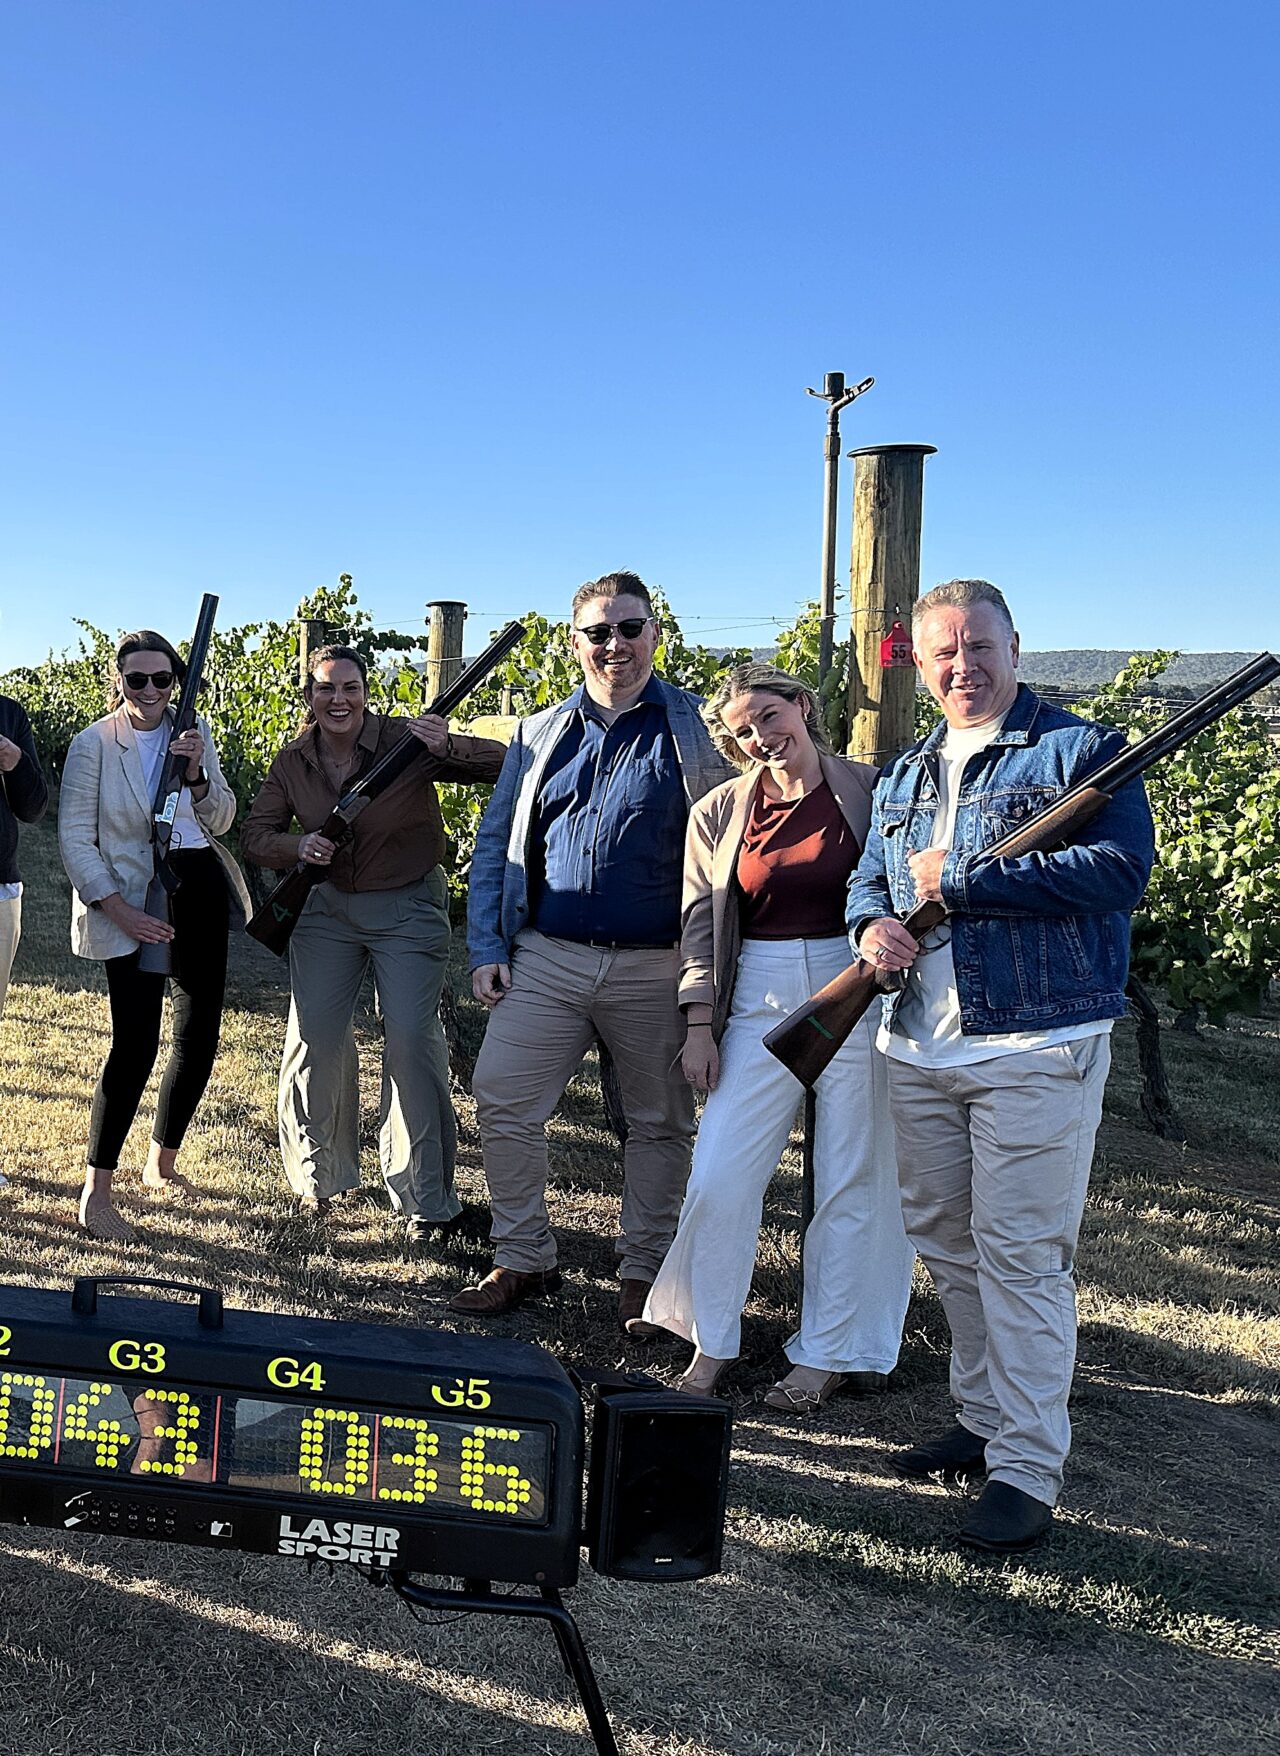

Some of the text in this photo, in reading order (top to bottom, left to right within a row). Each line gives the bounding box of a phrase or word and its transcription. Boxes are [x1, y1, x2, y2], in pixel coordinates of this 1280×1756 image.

[891, 644, 907, 660] 55
[108, 1340, 166, 1373] G3
[266, 1357, 326, 1391] G4
[431, 1378, 491, 1409] G5
[279, 1515, 400, 1550] LASER
[277, 1539, 398, 1566] SPORT
